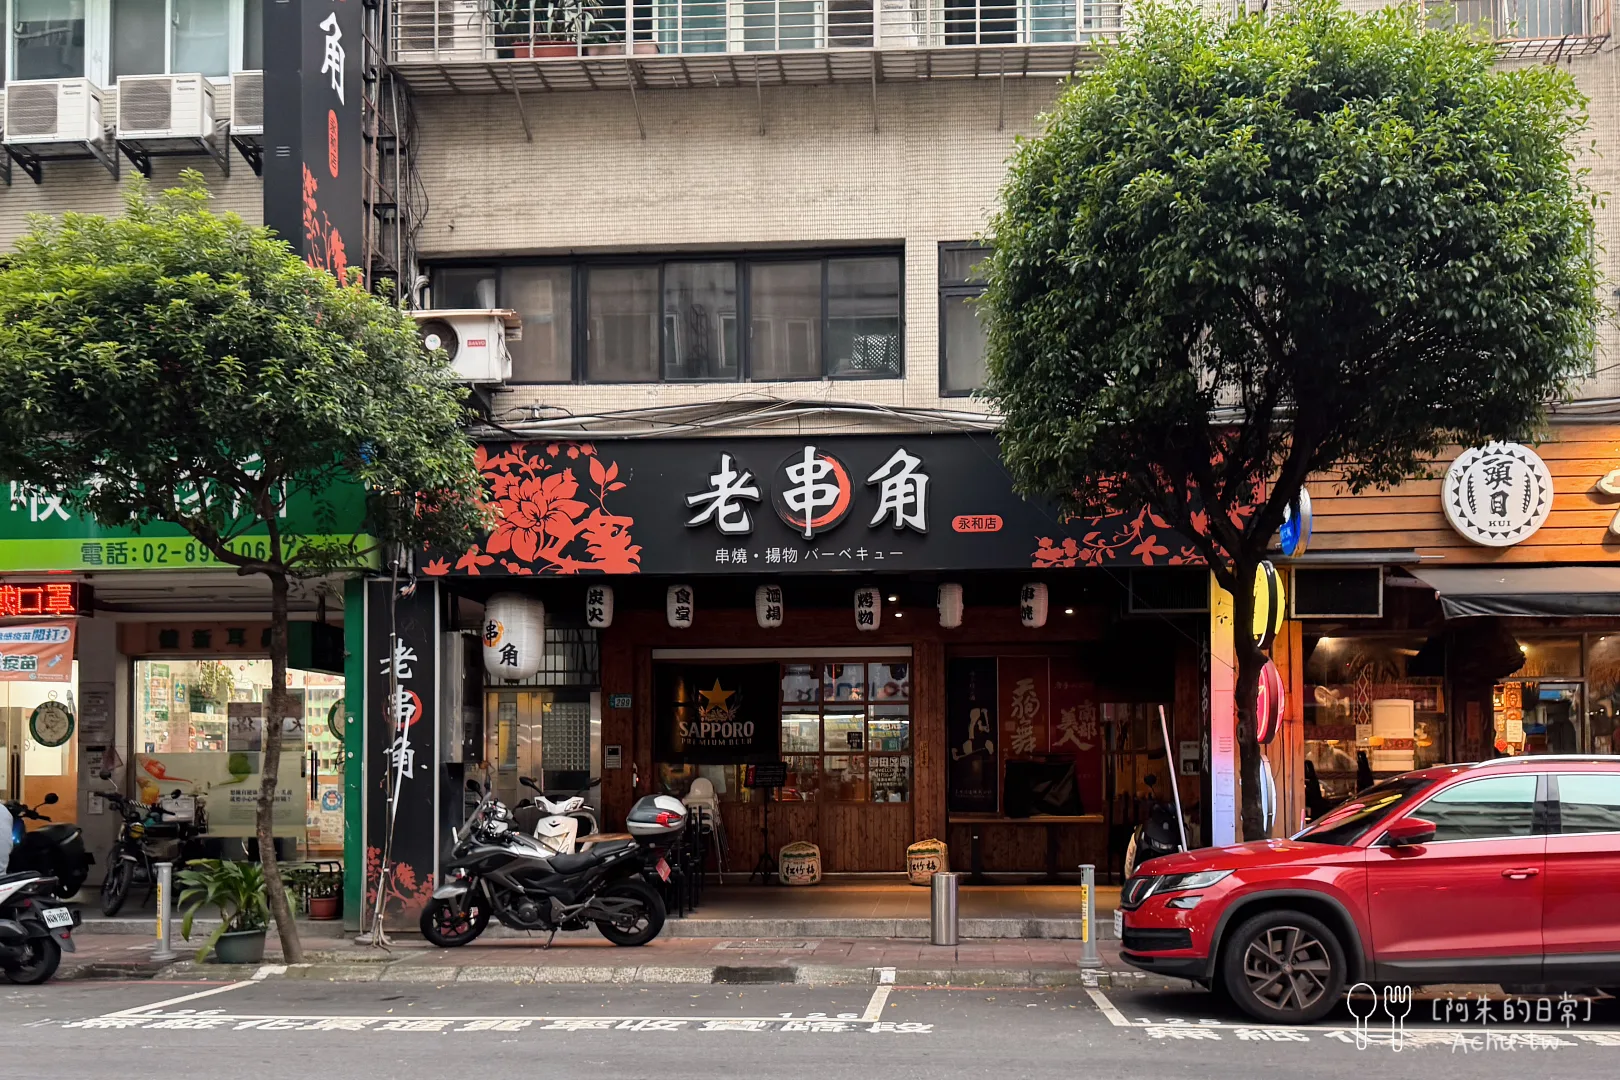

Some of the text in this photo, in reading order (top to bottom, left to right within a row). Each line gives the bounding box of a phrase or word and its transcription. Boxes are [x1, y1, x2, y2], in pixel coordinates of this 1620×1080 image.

[686, 445, 930, 538] 老串角
[957, 517, 997, 531] 永和店
[588, 588, 604, 623] 炭火
[674, 588, 691, 622] 食堂
[765, 588, 781, 621] 酒場
[615, 698, 631, 707] 299
[679, 721, 755, 739] SAPPORO
[681, 738, 726, 746] PREMIUM
[778, 1012, 860, 1020] 126
